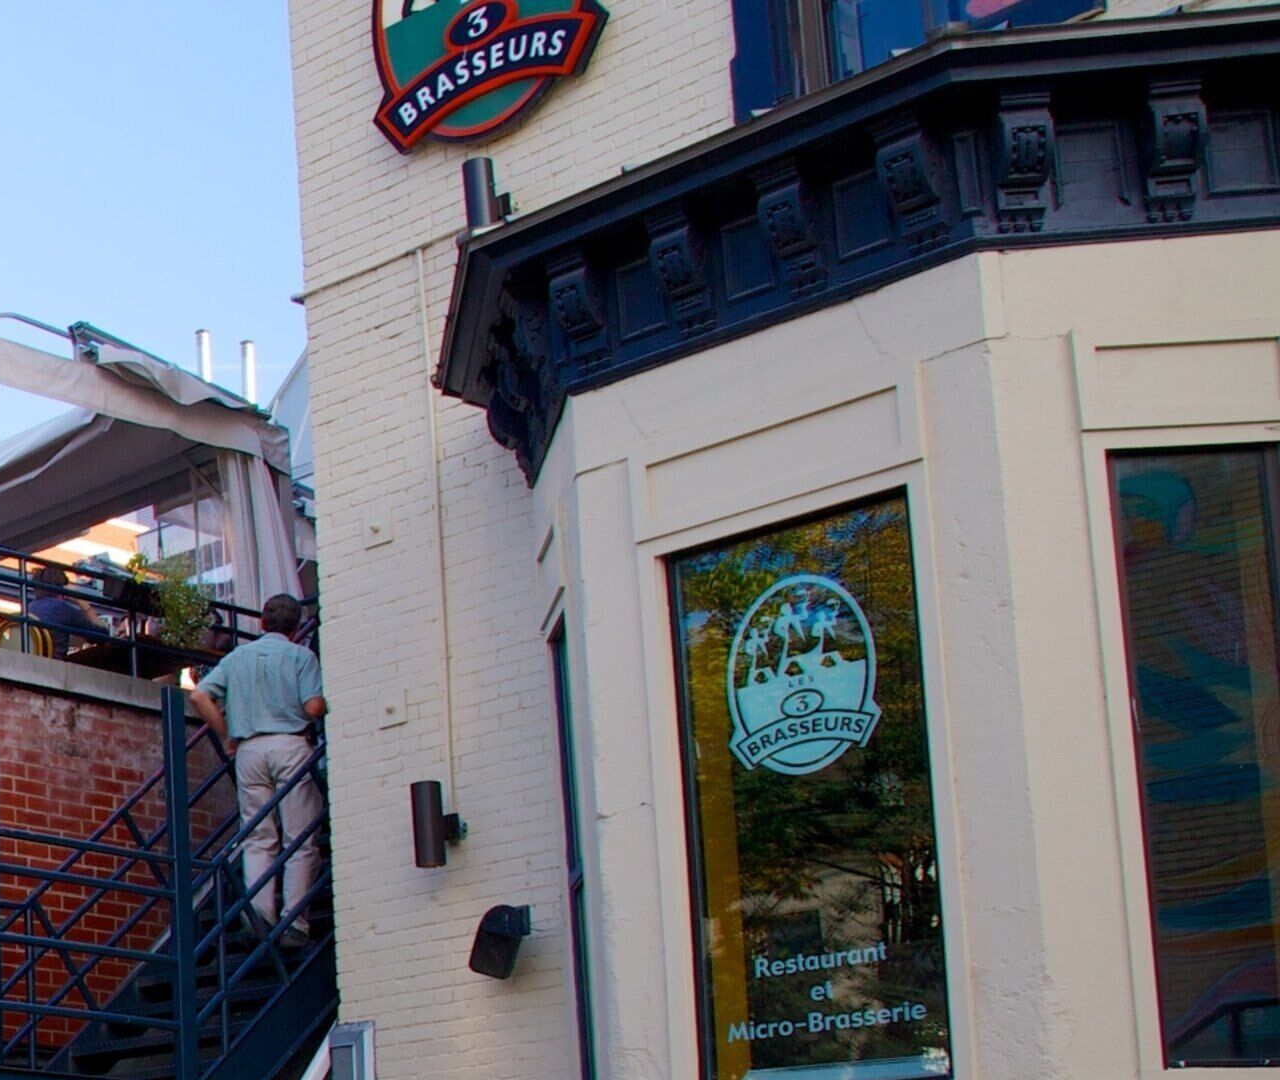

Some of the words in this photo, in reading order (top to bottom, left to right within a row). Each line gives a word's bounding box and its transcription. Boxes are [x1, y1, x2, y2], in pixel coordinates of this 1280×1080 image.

[467, 6, 488, 38] 3
[397, 29, 567, 127] BRASSEURS
[788, 676, 814, 688] LES
[795, 695, 810, 713] 3
[746, 716, 866, 758] BRASSEURS
[754, 941, 888, 979] Restaurant
[809, 979, 835, 1001] et
[727, 1001, 928, 1044] Micro-Brasserie
